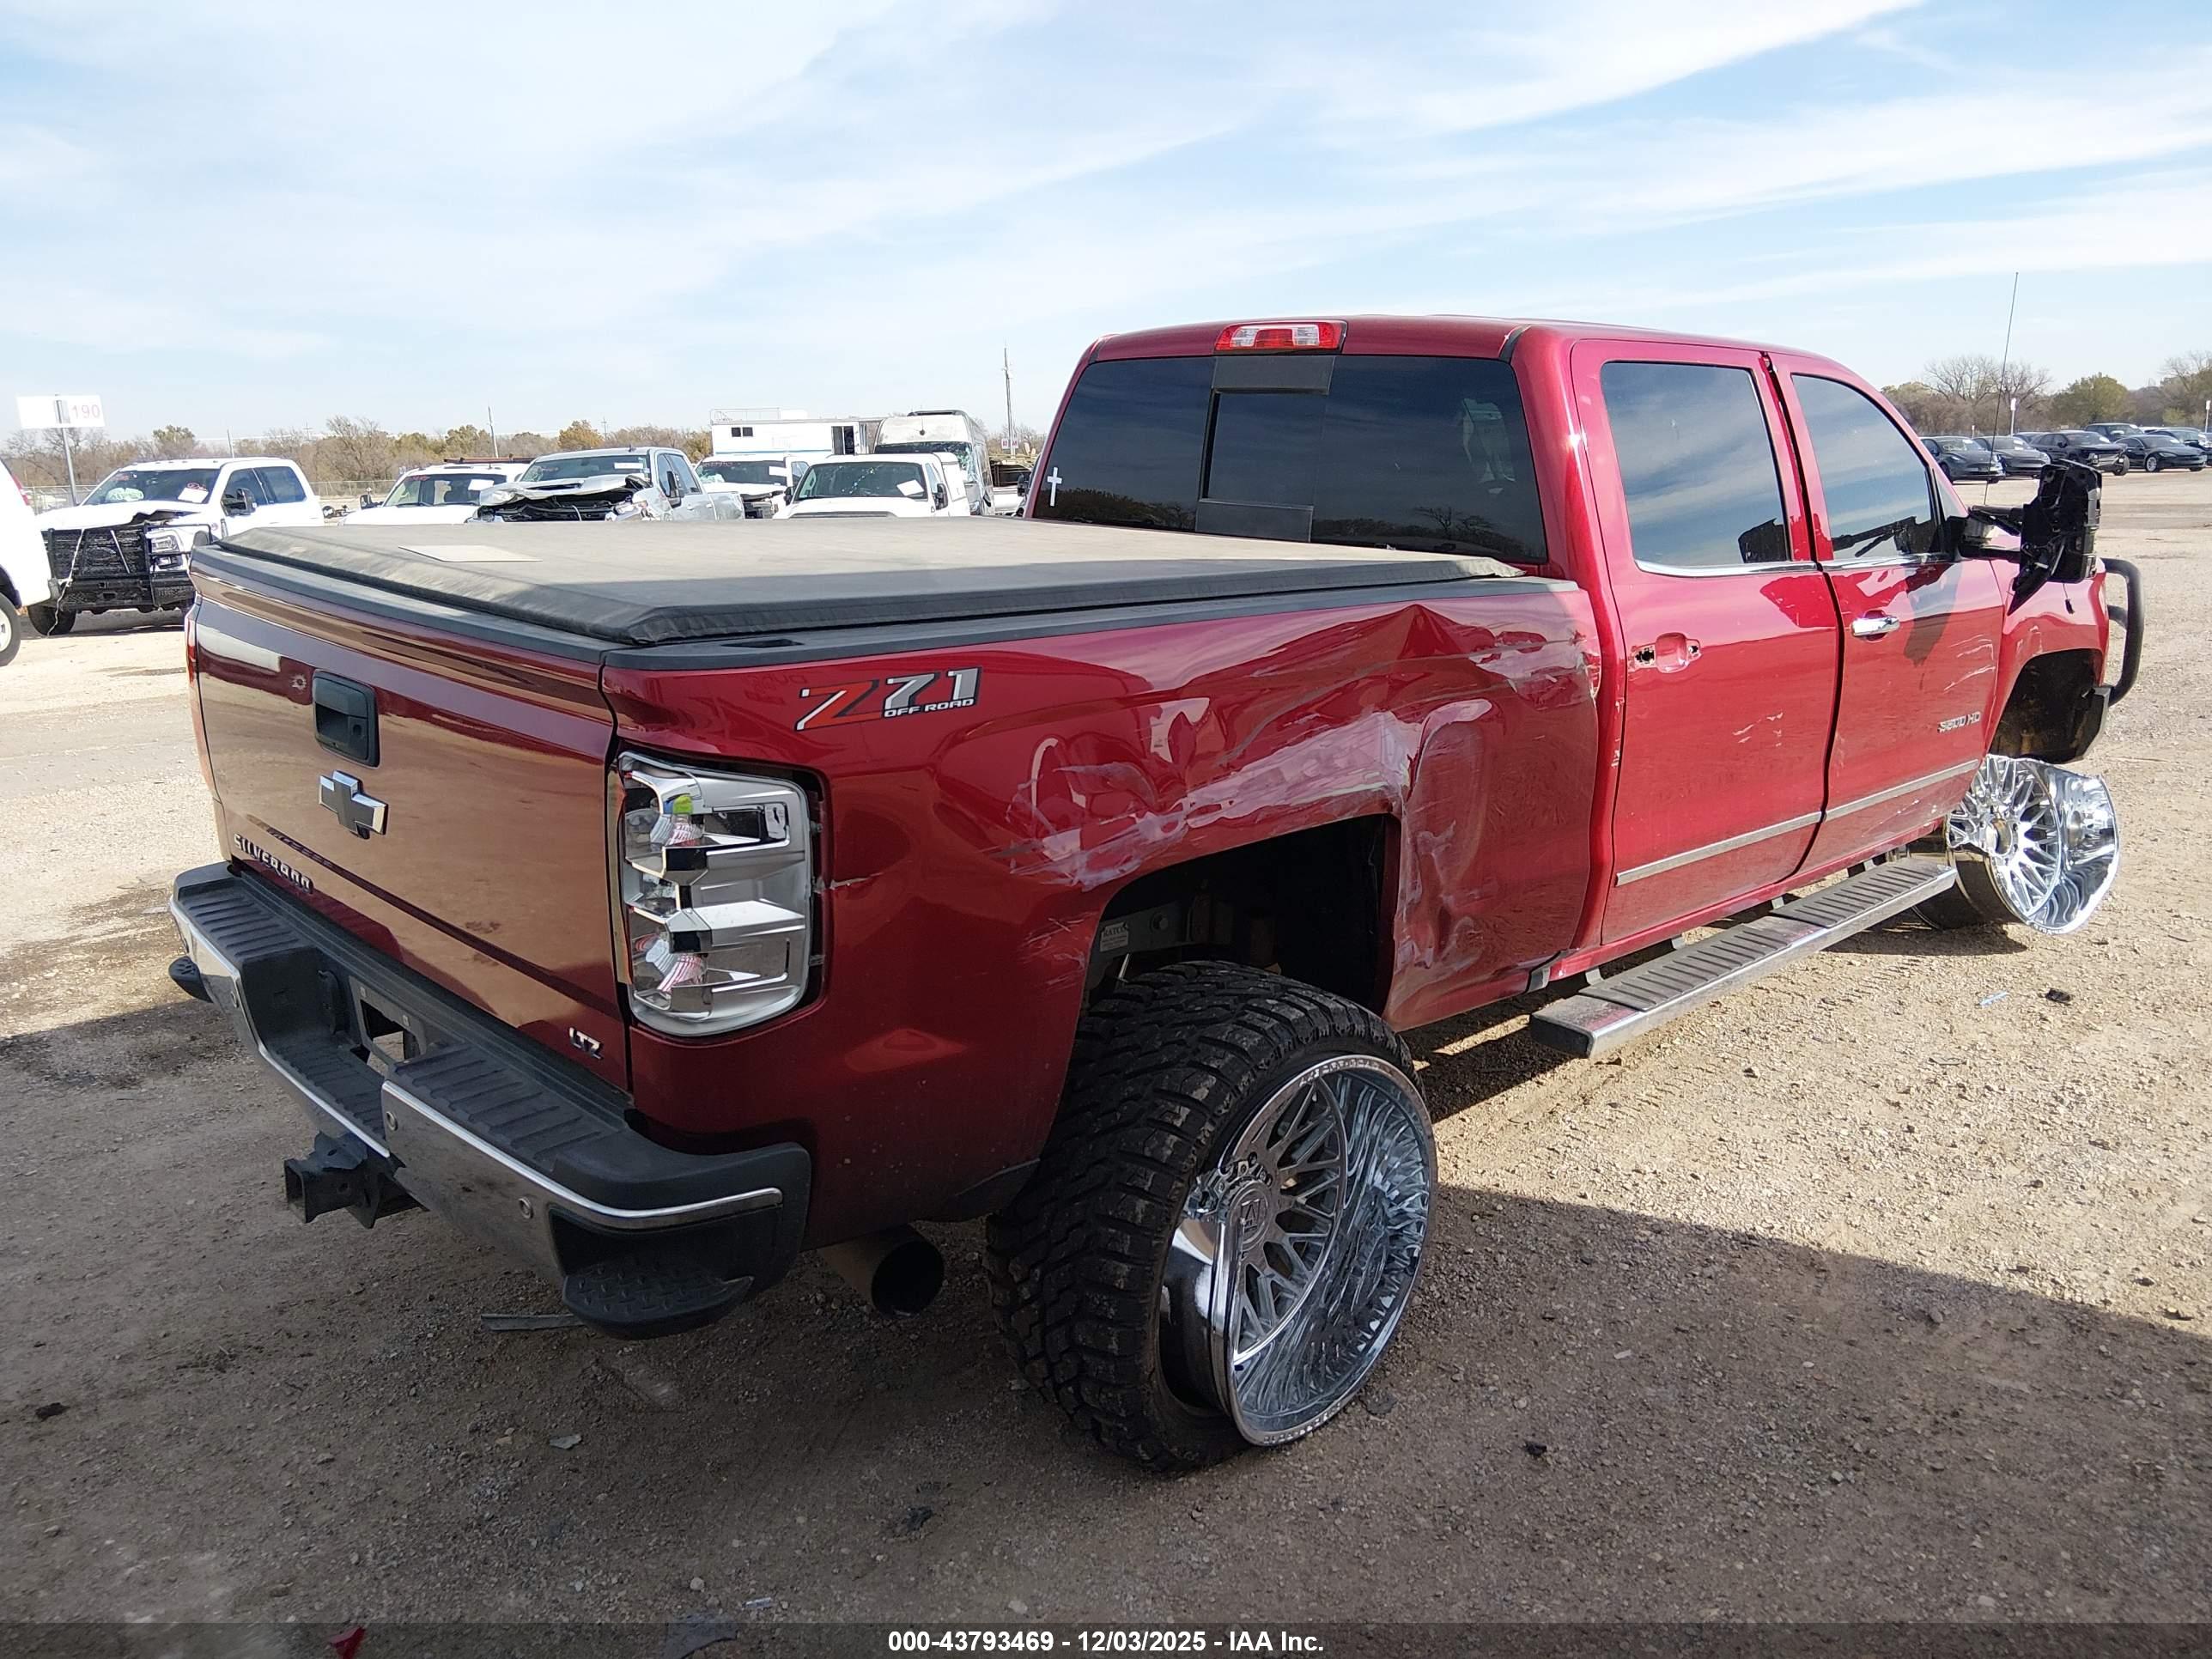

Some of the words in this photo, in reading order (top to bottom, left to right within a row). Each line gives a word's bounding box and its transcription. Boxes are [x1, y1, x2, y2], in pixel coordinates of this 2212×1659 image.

[71, 404, 100, 419] 190
[795, 667, 981, 731] Z71
[884, 706, 921, 718] OFF
[924, 698, 975, 713] ROAD
[568, 1026, 604, 1060] LTZ
